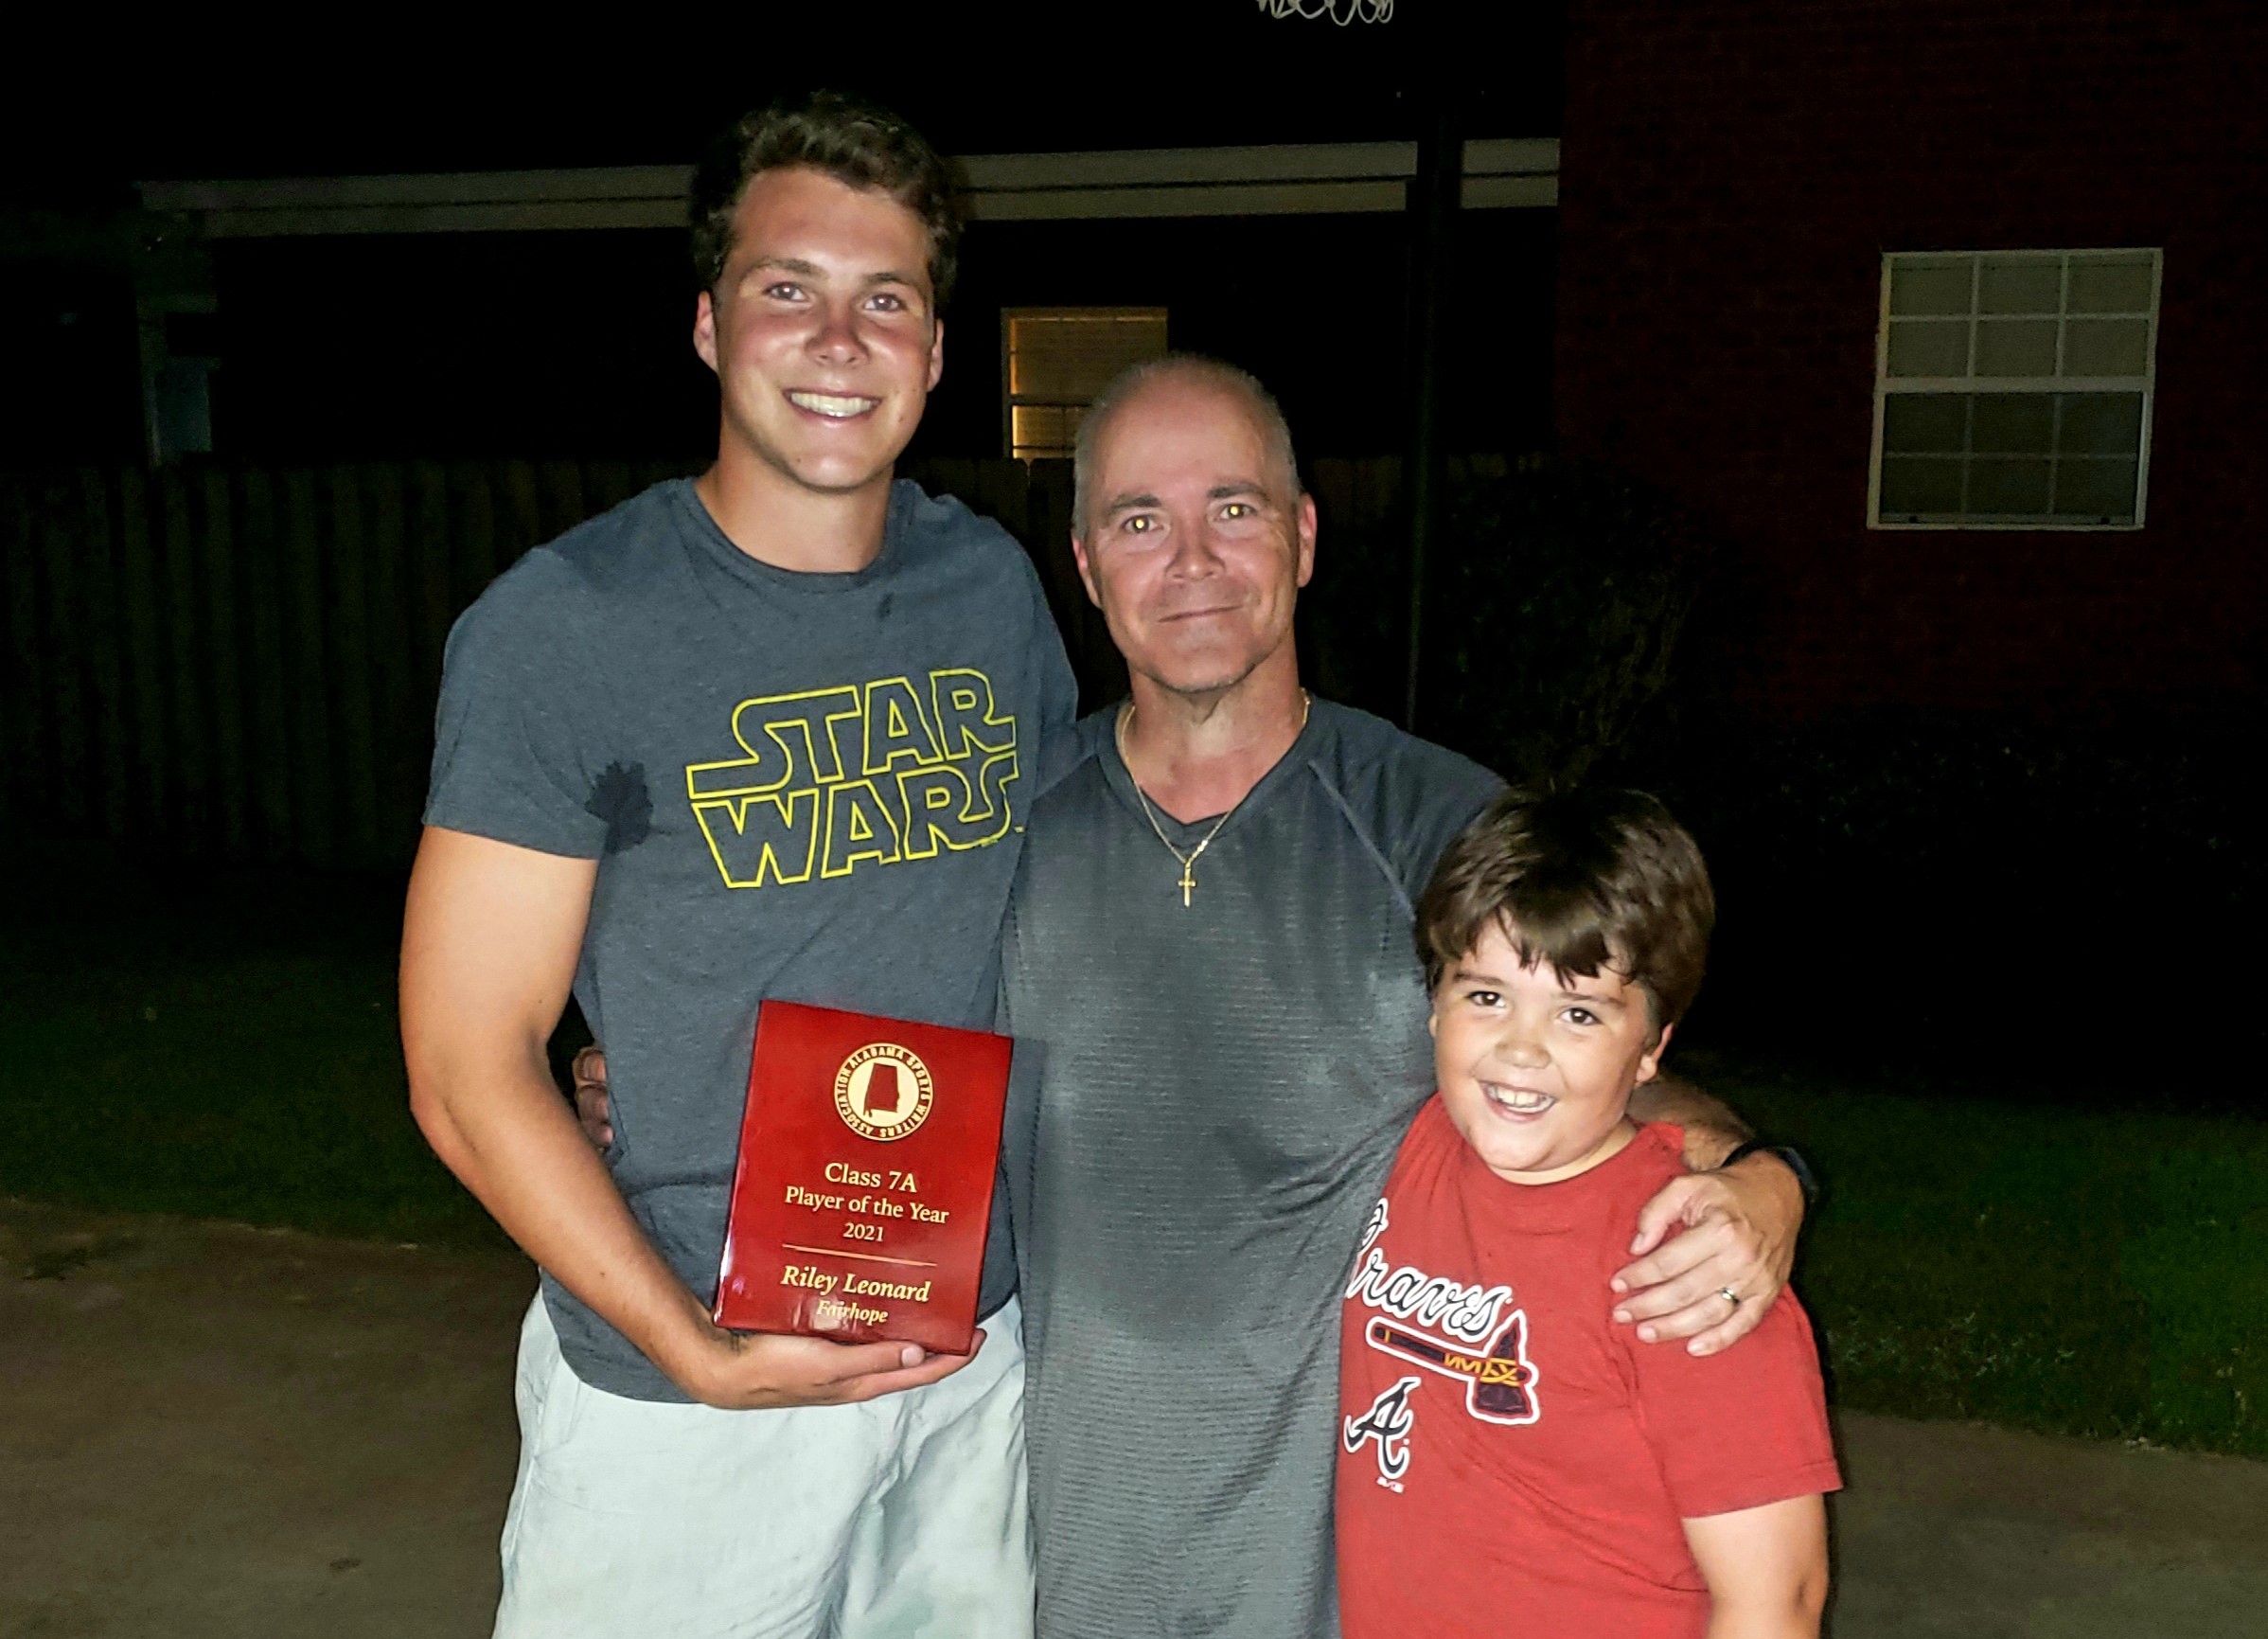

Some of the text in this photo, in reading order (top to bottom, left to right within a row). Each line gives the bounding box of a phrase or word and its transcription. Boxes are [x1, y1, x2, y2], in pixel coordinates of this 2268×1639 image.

[686, 668, 1017, 800] STAR
[691, 751, 1019, 889] WARS
[837, 1046, 930, 1138] ALABAMA SPORTS WRITERS ASSOCIATION
[824, 1162, 918, 1193] Class 7A
[785, 1185, 950, 1224] Player of the Year
[842, 1222, 884, 1241] 2021
[780, 1265, 931, 1302] Riley Leonard
[816, 1300, 889, 1326] Fairhope
